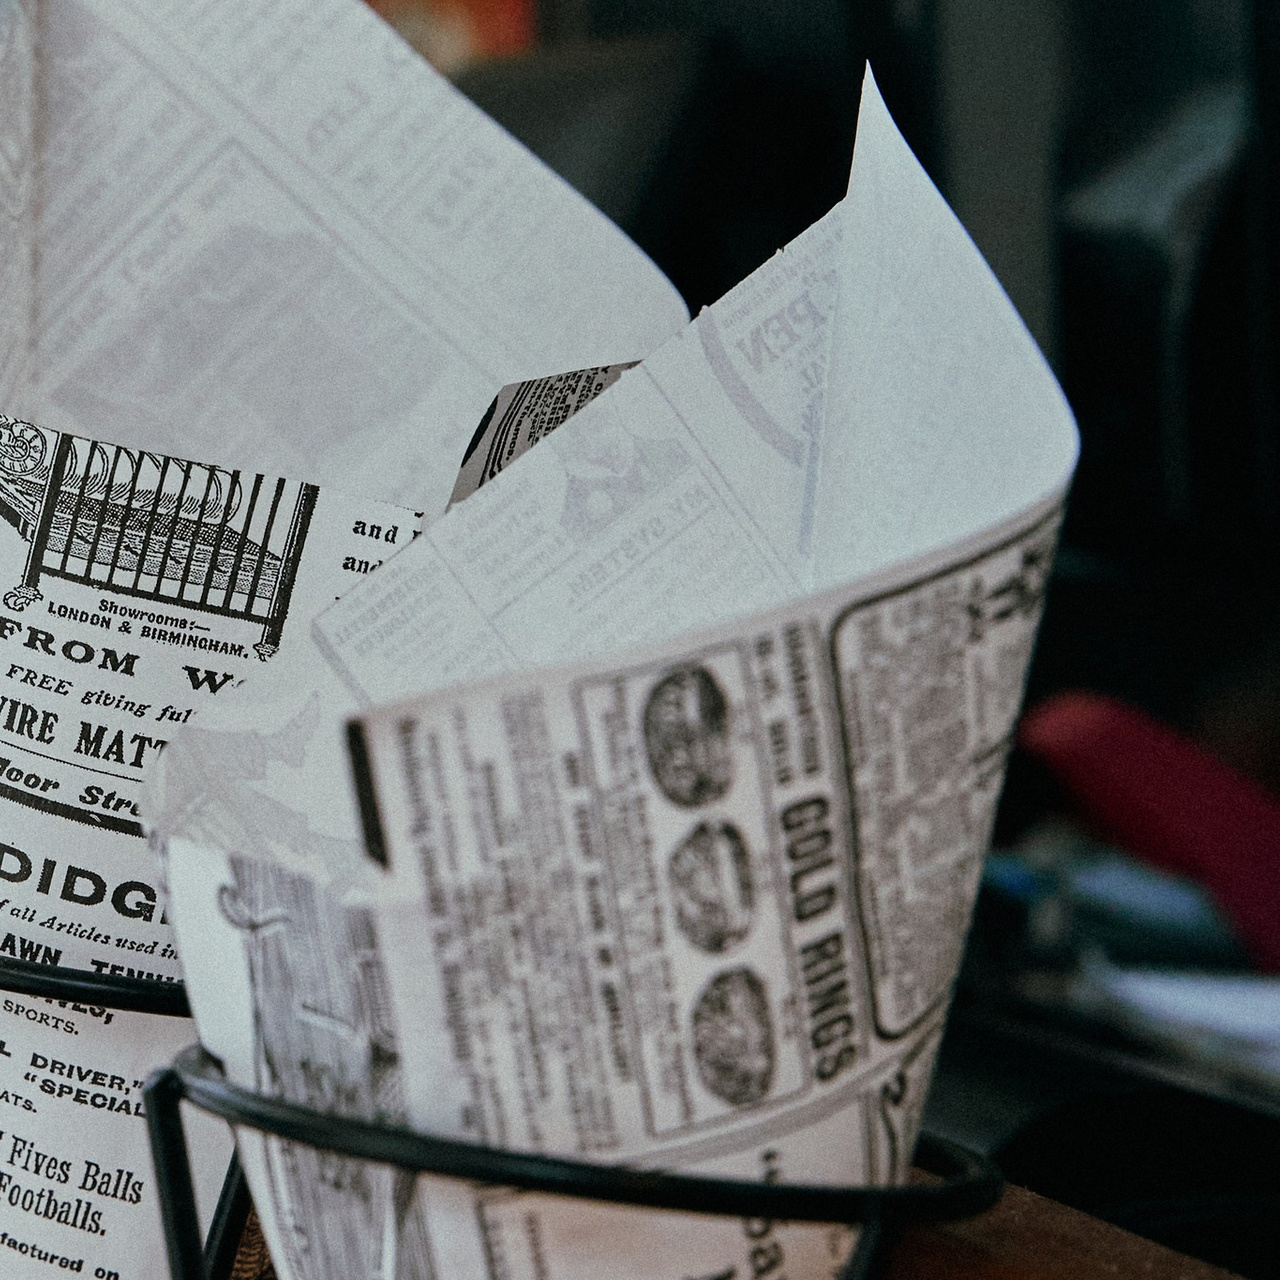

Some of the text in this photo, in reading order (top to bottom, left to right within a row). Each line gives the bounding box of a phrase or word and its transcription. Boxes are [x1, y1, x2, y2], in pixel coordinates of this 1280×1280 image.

[353, 520, 398, 544] and
[48, 601, 249, 659] LONDON & BIRMINGHAM.
[6, 664, 73, 696] FREE
[81, 689, 151, 717] giving
[156, 705, 196, 725] ful
[182, 665, 246, 695] W
[780, 794, 837, 925] GOLD
[10, 907, 36, 922] all
[39, 916, 111, 945] Articles
[115, 937, 159, 955] used
[161, 944, 179, 959] in
[2, 999, 79, 1035] SPORTS.
[800, 929, 861, 1082] RINGS
[30, 1052, 144, 1095] DRIVER,”
[7, 1134, 72, 1184] Fives
[78, 1160, 145, 1205] Balls
